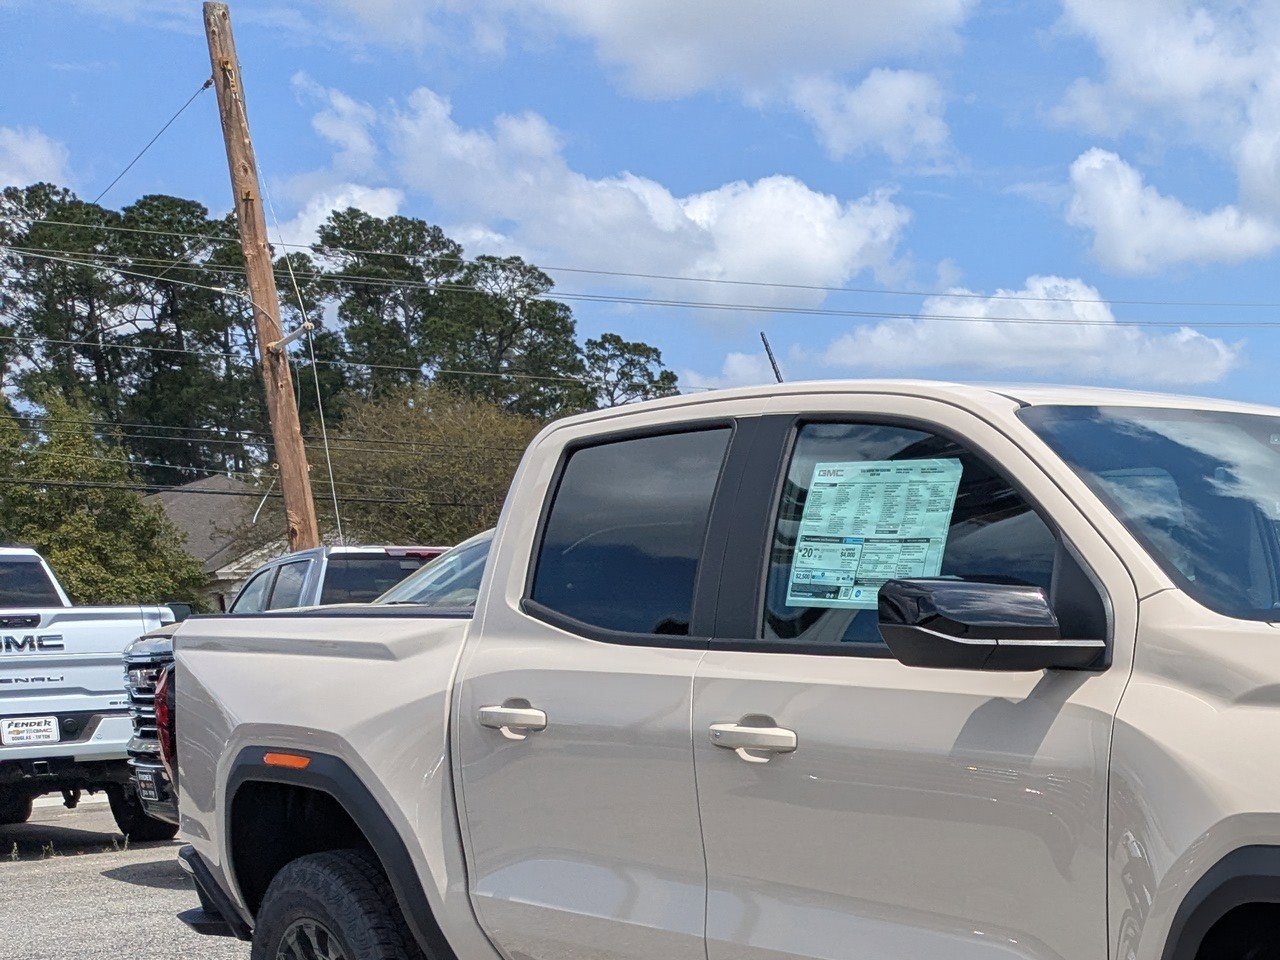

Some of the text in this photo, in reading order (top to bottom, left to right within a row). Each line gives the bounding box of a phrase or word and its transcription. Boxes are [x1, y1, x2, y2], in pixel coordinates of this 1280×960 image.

[818, 469, 844, 477] GMC
[802, 548, 813, 557] 20
[0, 634, 65, 653] MC
[8, 720, 51, 729] FENDER
